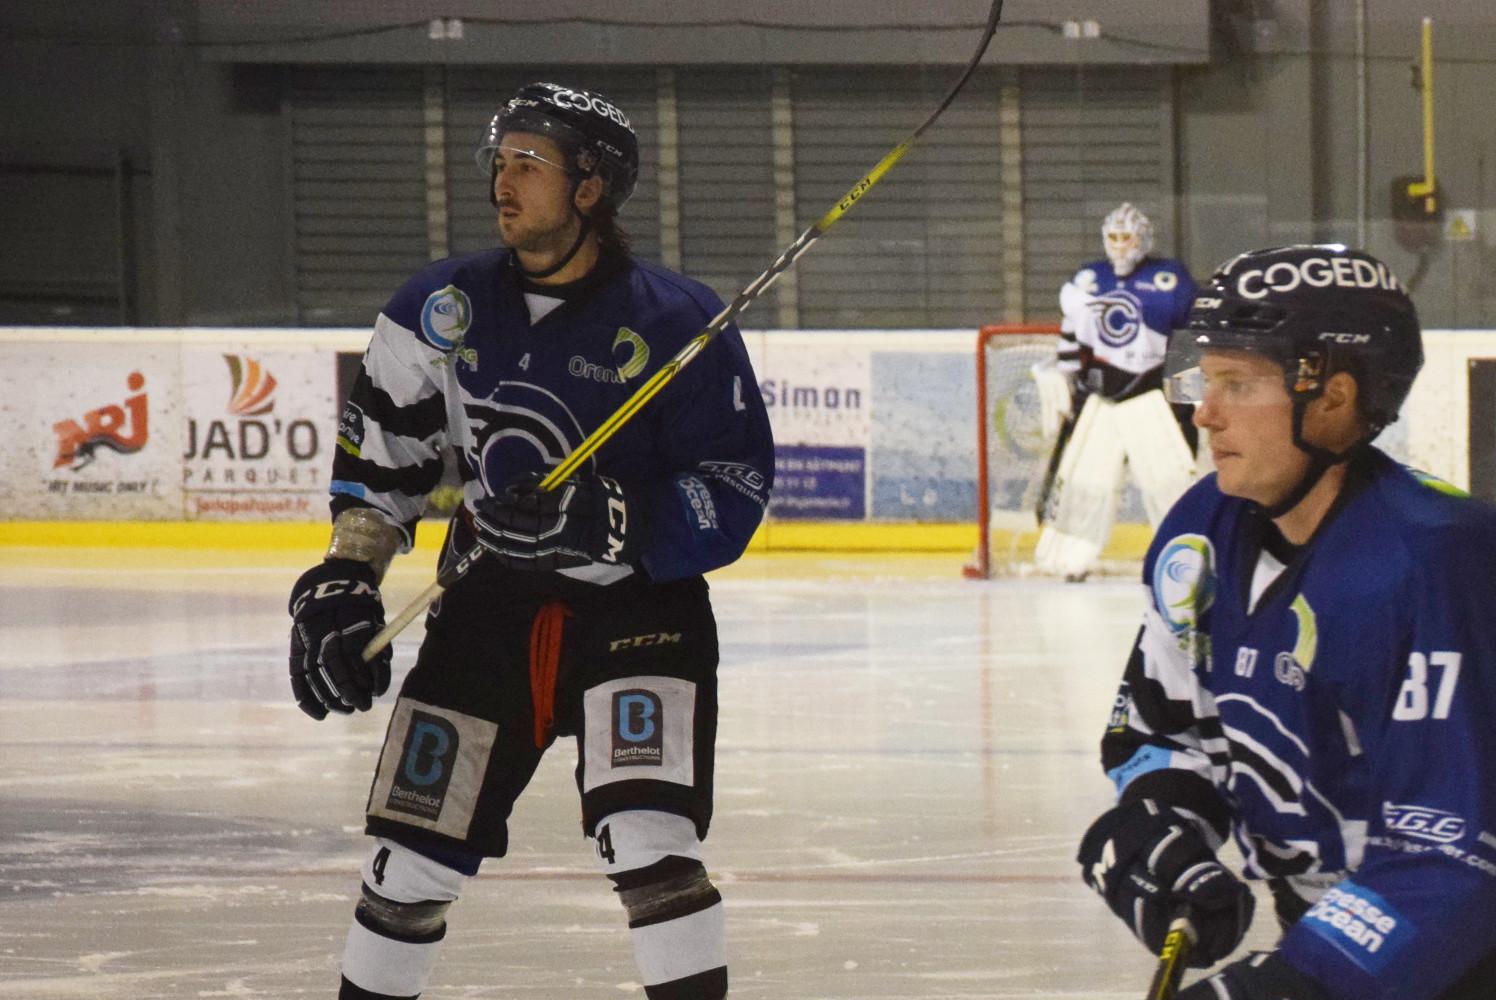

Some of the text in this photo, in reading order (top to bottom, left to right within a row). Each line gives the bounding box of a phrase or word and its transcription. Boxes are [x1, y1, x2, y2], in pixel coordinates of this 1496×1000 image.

[518, 353, 531, 371] 4
[183, 420, 319, 460] JAD'O
[183, 466, 320, 484] PARQUET
[1392, 651, 1462, 721] 87
[614, 746, 661, 758] Berthelot
[597, 823, 616, 865] 4
[372, 846, 391, 886] 4
